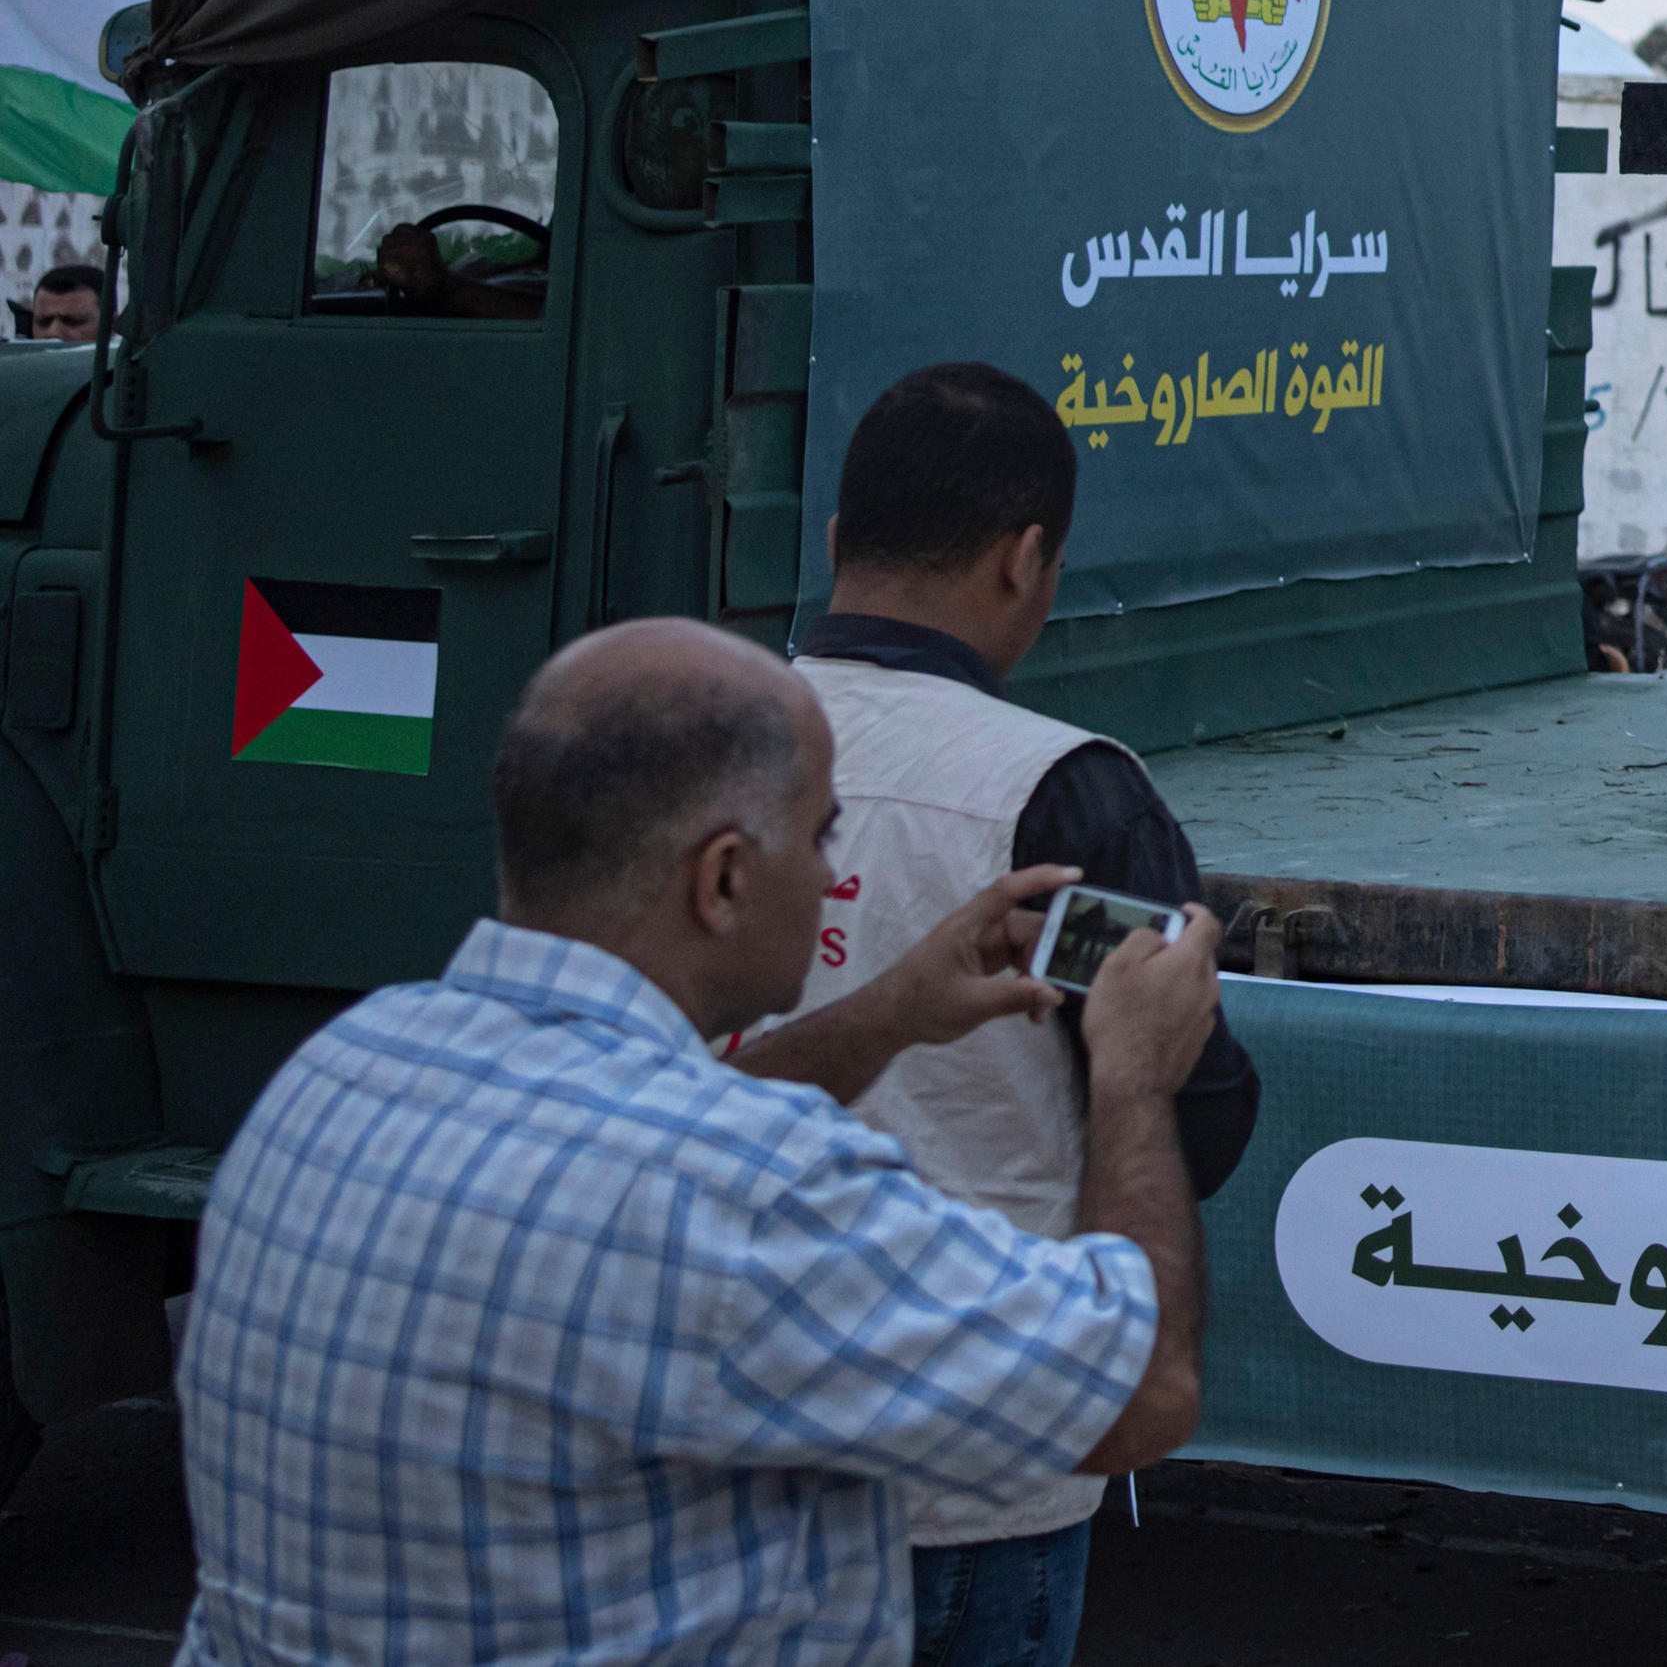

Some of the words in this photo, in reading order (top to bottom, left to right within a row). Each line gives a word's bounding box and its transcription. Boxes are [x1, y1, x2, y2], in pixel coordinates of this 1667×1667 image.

[1061, 203, 1226, 308] القدس
[1234, 209, 1388, 298] سرايا
[1055, 348, 1280, 449] الصاروخية
[1284, 340, 1385, 434] القوة
